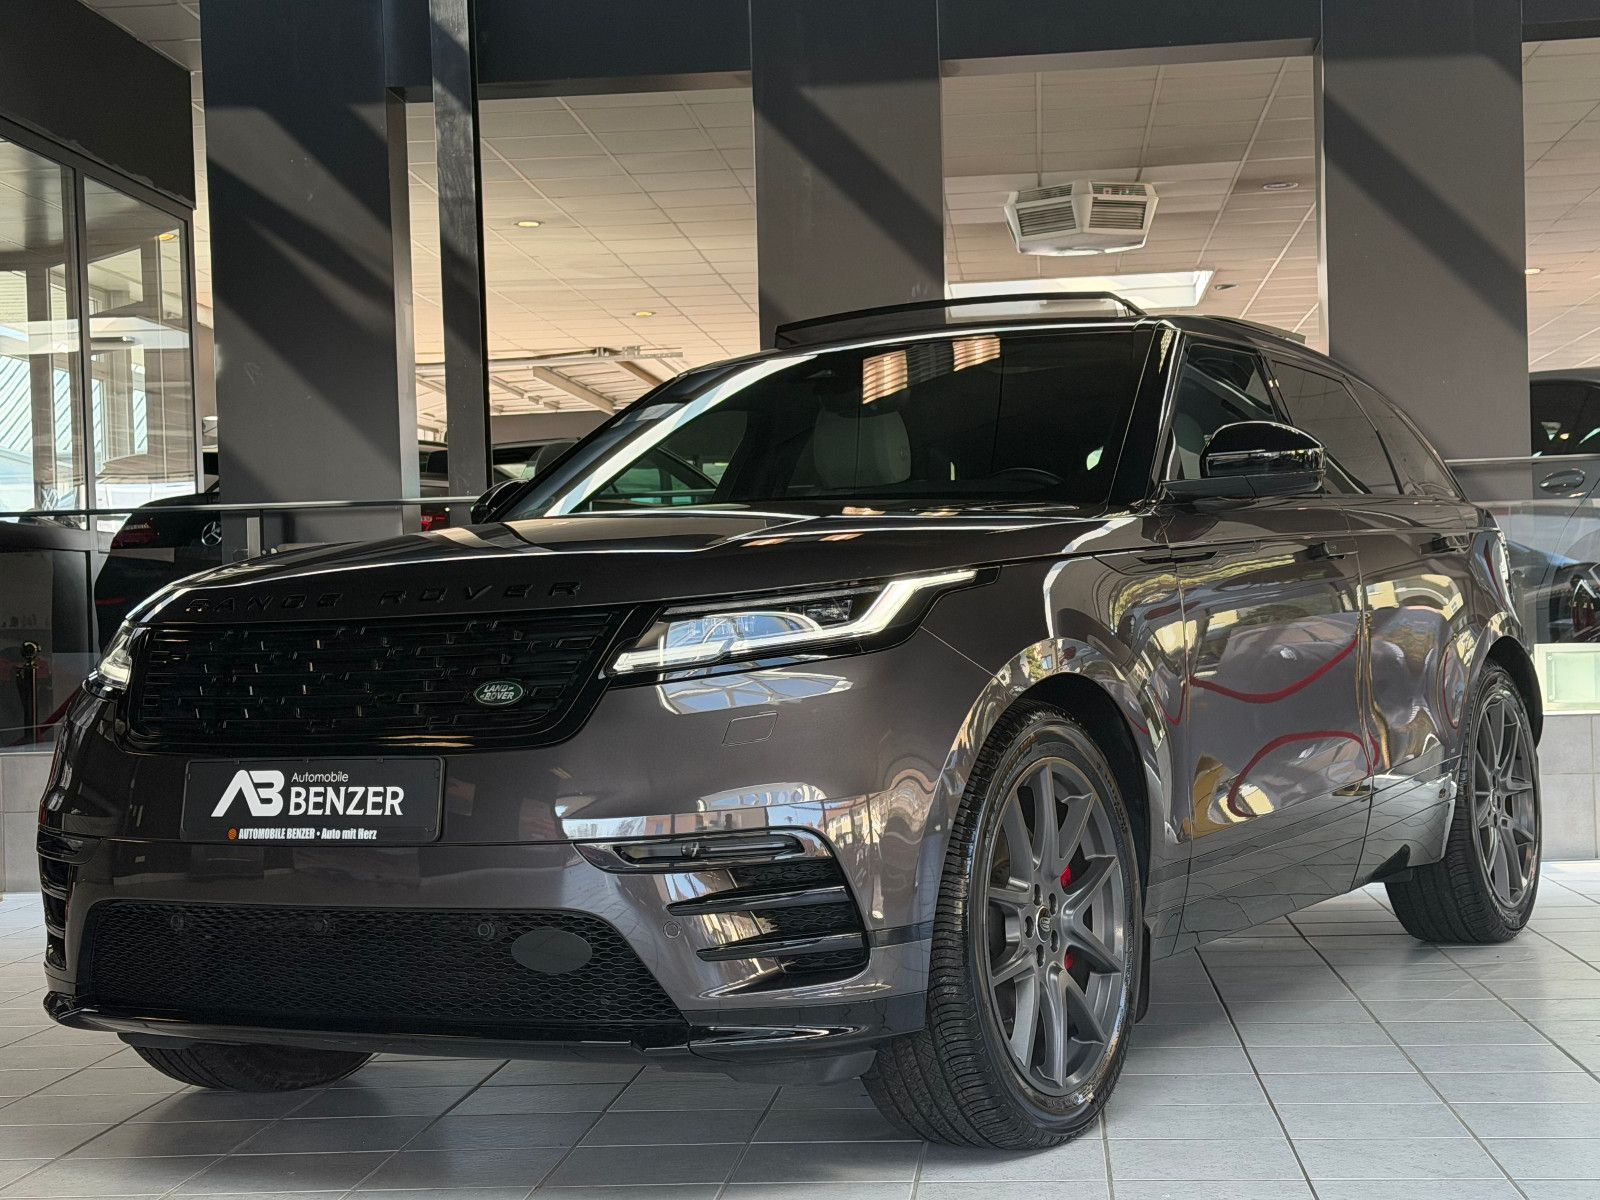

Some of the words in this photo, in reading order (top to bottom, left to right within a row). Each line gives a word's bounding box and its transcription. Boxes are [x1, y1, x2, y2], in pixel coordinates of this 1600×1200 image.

[483, 684, 509, 693] LAND
[483, 691, 515, 701] ROVER
[291, 771, 349, 783] Automobile
[288, 786, 405, 816] BENZER
[238, 827, 286, 840] AUTOMOBILE
[286, 827, 315, 840] BENZER
[320, 827, 341, 840] Auto
[341, 827, 357, 840] mit
[357, 827, 377, 840] Herz
